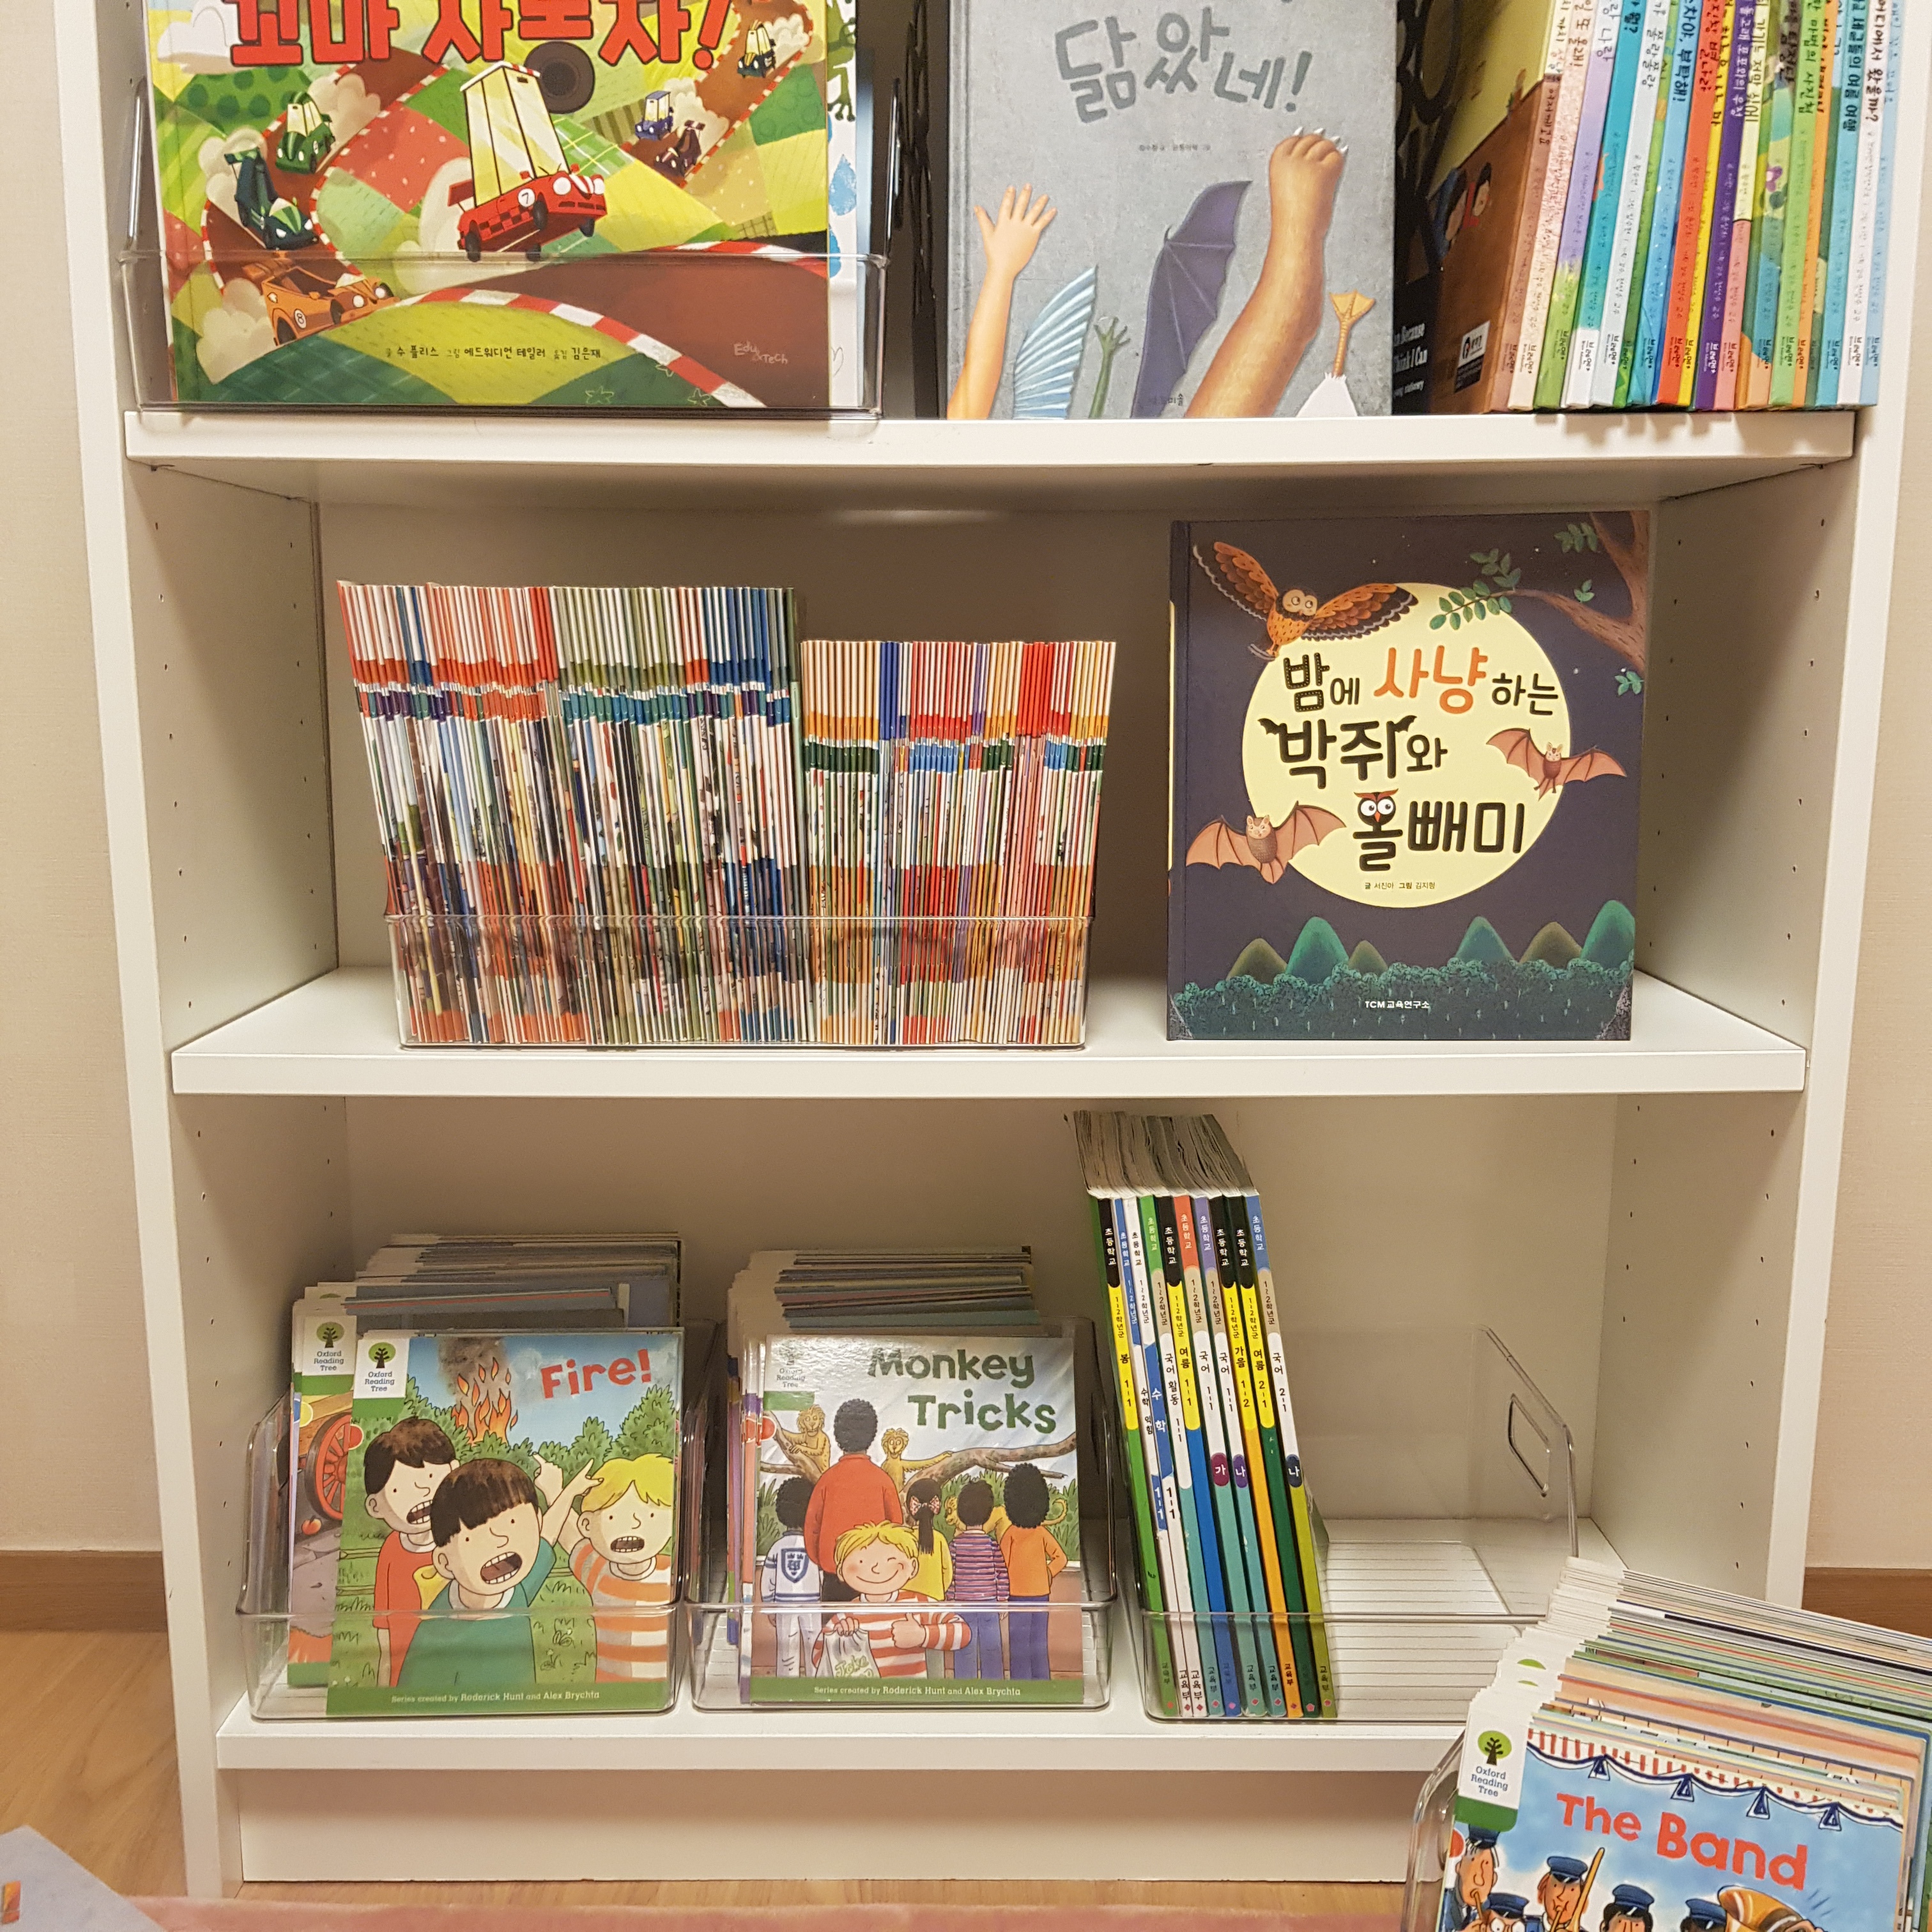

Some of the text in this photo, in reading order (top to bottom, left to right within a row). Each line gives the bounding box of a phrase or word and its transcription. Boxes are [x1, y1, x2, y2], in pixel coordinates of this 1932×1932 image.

[1575, 16, 1591, 31] 또
[1736, 5, 1754, 41] 돌고래
[1595, 27, 1618, 63] 나랑
[1802, 19, 1820, 62] 마법의
[1671, 48, 1692, 102] 부탁해!
[1844, 73, 1860, 98] 여름
[1729, 93, 1745, 117] 우정
[1798, 71, 1816, 114] 사진첩
[1863, 67, 1883, 122] 왔을까?
[1841, 104, 1859, 132] 여행
[521, 192, 530, 204] 7
[397, 346, 406, 356] 수
[410, 345, 439, 358] 플리스
[464, 346, 512, 359] 에드워디언
[516, 347, 545, 360] 테일러
[571, 347, 601, 360] 김은재
[1283, 652, 1360, 712] 밤에
[1277, 717, 1448, 790] 박쥐와
[1353, 788, 1525, 871] 올빼미
[1105, 1228, 1116, 1265] 초등학교
[1121, 1232, 1130, 1266] 초등학교
[1132, 1232, 1142, 1266] 초등학교
[1147, 1218, 1157, 1250] 초등학교
[1165, 1227, 1177, 1264] 초등학교
[1181, 1215, 1192, 1249] 초등학교
[1200, 1216, 1211, 1250] 초등학교
[1216, 1229, 1229, 1266] 초등학교
[1236, 1229, 1248, 1266] 초등학교
[1253, 1216, 1264, 1250] 초등학교
[540, 1348, 652, 1399] Fire!
[868, 1347, 1035, 1388] Monkey
[1120, 1354, 1130, 1363] 봄
[1165, 1354, 1174, 1374] 국어
[1179, 1347, 1190, 1368] 여름
[1169, 1381, 1179, 1406] 활동
[1235, 1346, 1250, 1407] 가을 1-2
[1254, 1349, 1267, 1407] 여름 2-1
[907, 1388, 1056, 1434] Tricks
[1140, 1388, 1149, 1406] 수학
[1145, 1416, 1153, 1435] 익힘
[1199, 1351, 1210, 1373] 국어
[1215, 1464, 1226, 1475] 가
[1219, 1353, 1232, 1374] 국어
[1235, 1466, 1246, 1477] 나
[1272, 1352, 1284, 1374] 국어
[1289, 1466, 1300, 1477] 나
[871, 1687, 880, 1695] by
[925, 1686, 946, 1694] Hunt
[986, 1687, 1020, 1696] Brychta
[1179, 1670, 1189, 1700] 교육부
[1191, 1671, 1201, 1699] 교육부
[1285, 1664, 1294, 1685] 교육부
[449, 1694, 459, 1703] by
[503, 1692, 524, 1701] Hunt
[565, 1692, 600, 1700] Brychta
[1471, 1774, 1508, 1791] Reading
[1476, 1766, 1506, 1779] Oxford
[1478, 1785, 1498, 1797] Tree
[1556, 1793, 1808, 1890] The Band
